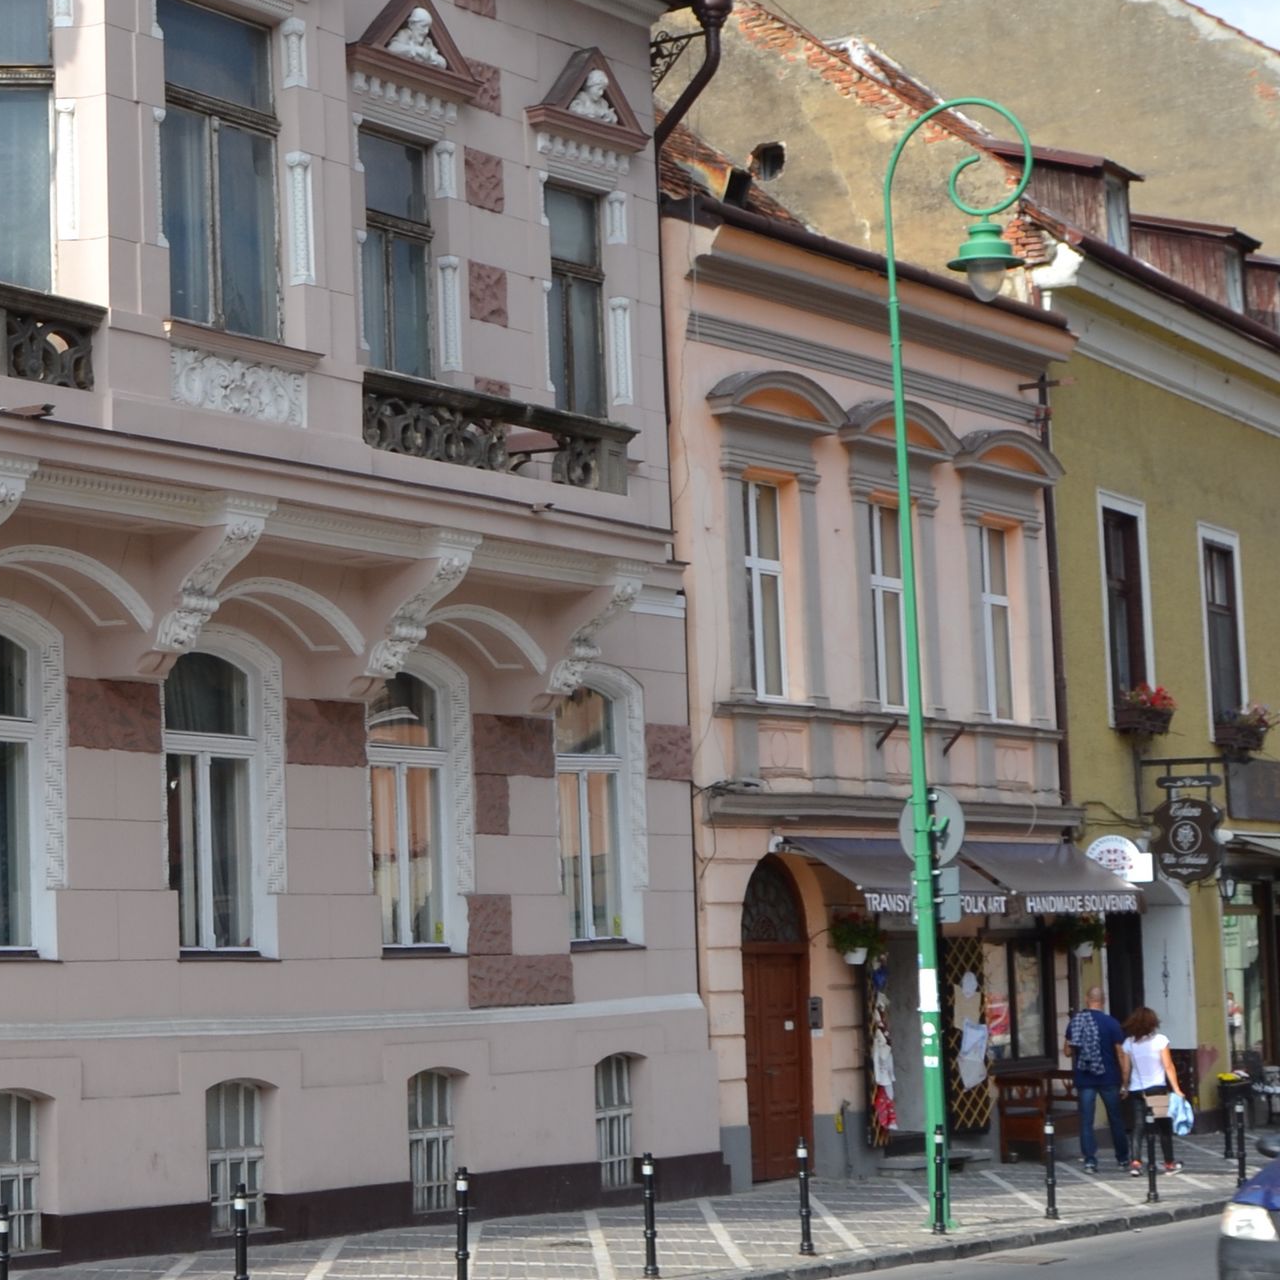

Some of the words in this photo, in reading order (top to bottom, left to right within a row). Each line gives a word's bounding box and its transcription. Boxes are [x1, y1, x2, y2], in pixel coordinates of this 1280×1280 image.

[987, 896, 1007, 913] ART
[1025, 894, 1083, 913] HANDMADE
[1084, 893, 1138, 912] SOUVENIRS
